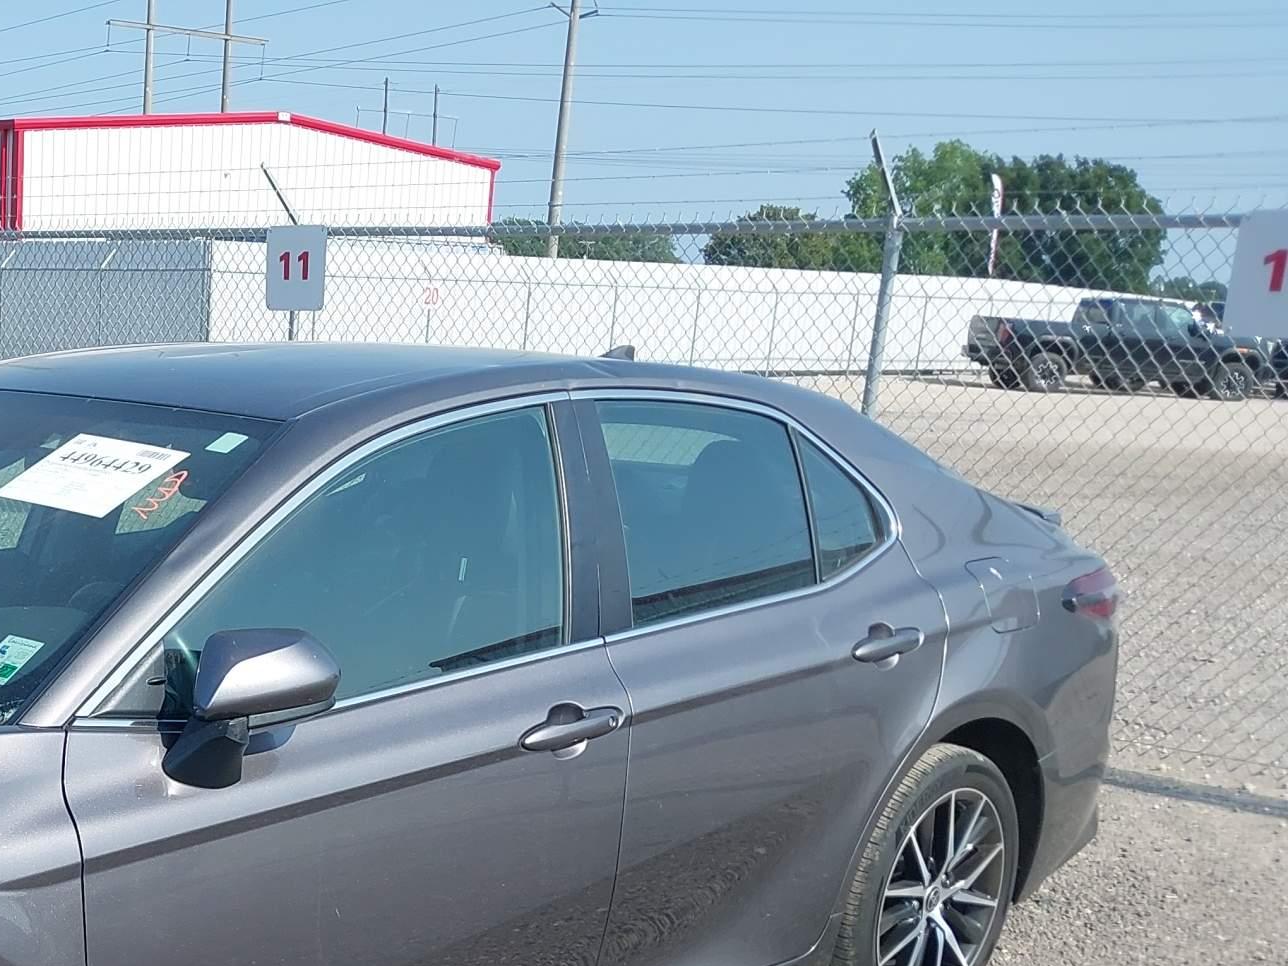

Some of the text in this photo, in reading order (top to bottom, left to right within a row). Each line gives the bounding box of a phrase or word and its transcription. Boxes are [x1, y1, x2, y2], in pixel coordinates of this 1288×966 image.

[279, 251, 309, 280] 11
[424, 287, 439, 305] 20
[60, 450, 152, 474] 44964429
